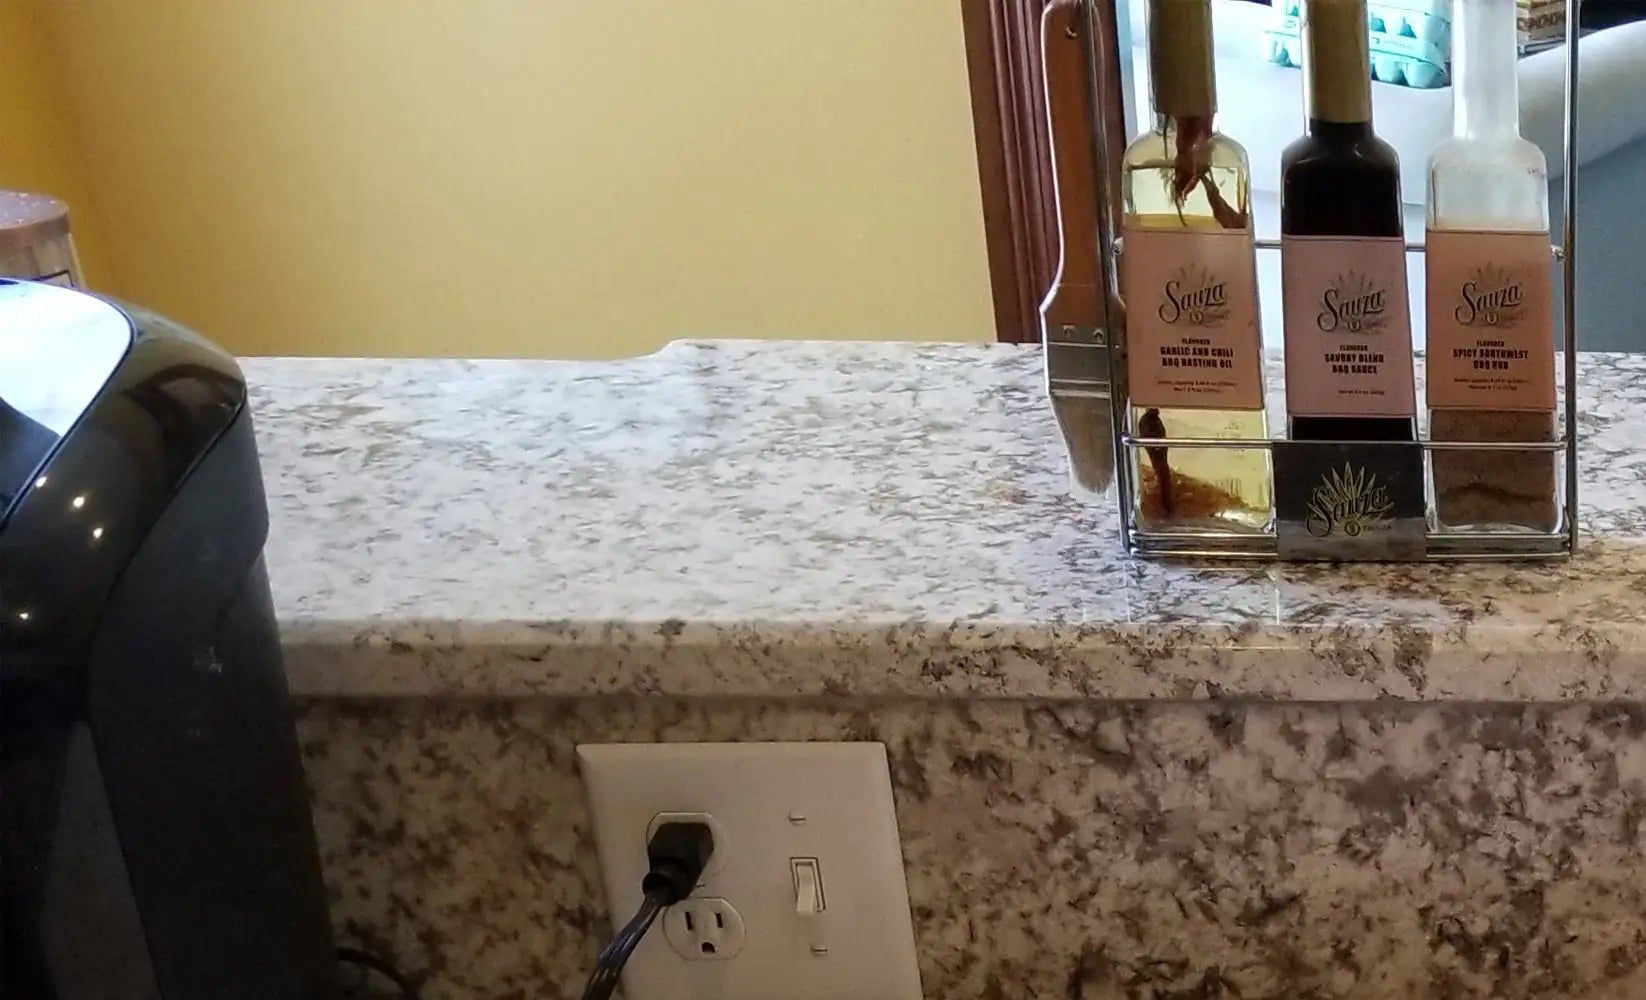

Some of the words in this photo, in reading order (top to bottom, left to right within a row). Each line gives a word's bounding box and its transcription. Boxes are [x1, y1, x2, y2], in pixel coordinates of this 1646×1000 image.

[1159, 280, 1226, 324] Sauza
[1455, 282, 1522, 325] Sauza
[1317, 288, 1385, 333] Sauza
[1160, 346, 1191, 356] GARLIC
[1192, 346, 1210, 357] AND
[1211, 347, 1234, 358] CHILI
[1453, 348, 1477, 357] SPICY
[1479, 348, 1529, 360] SOUTHWEST
[1162, 357, 1180, 368] BBQ
[1181, 358, 1219, 369] BASTING
[1220, 359, 1233, 369] OIL
[1325, 353, 1357, 363] SAVORY
[1358, 353, 1385, 364] BLEND
[1332, 364, 1349, 374] BBQ
[1351, 364, 1378, 374] SAUCE
[1473, 360, 1490, 370] BBQ
[1492, 360, 1509, 370] RUB
[1306, 485, 1394, 537] Sauza
